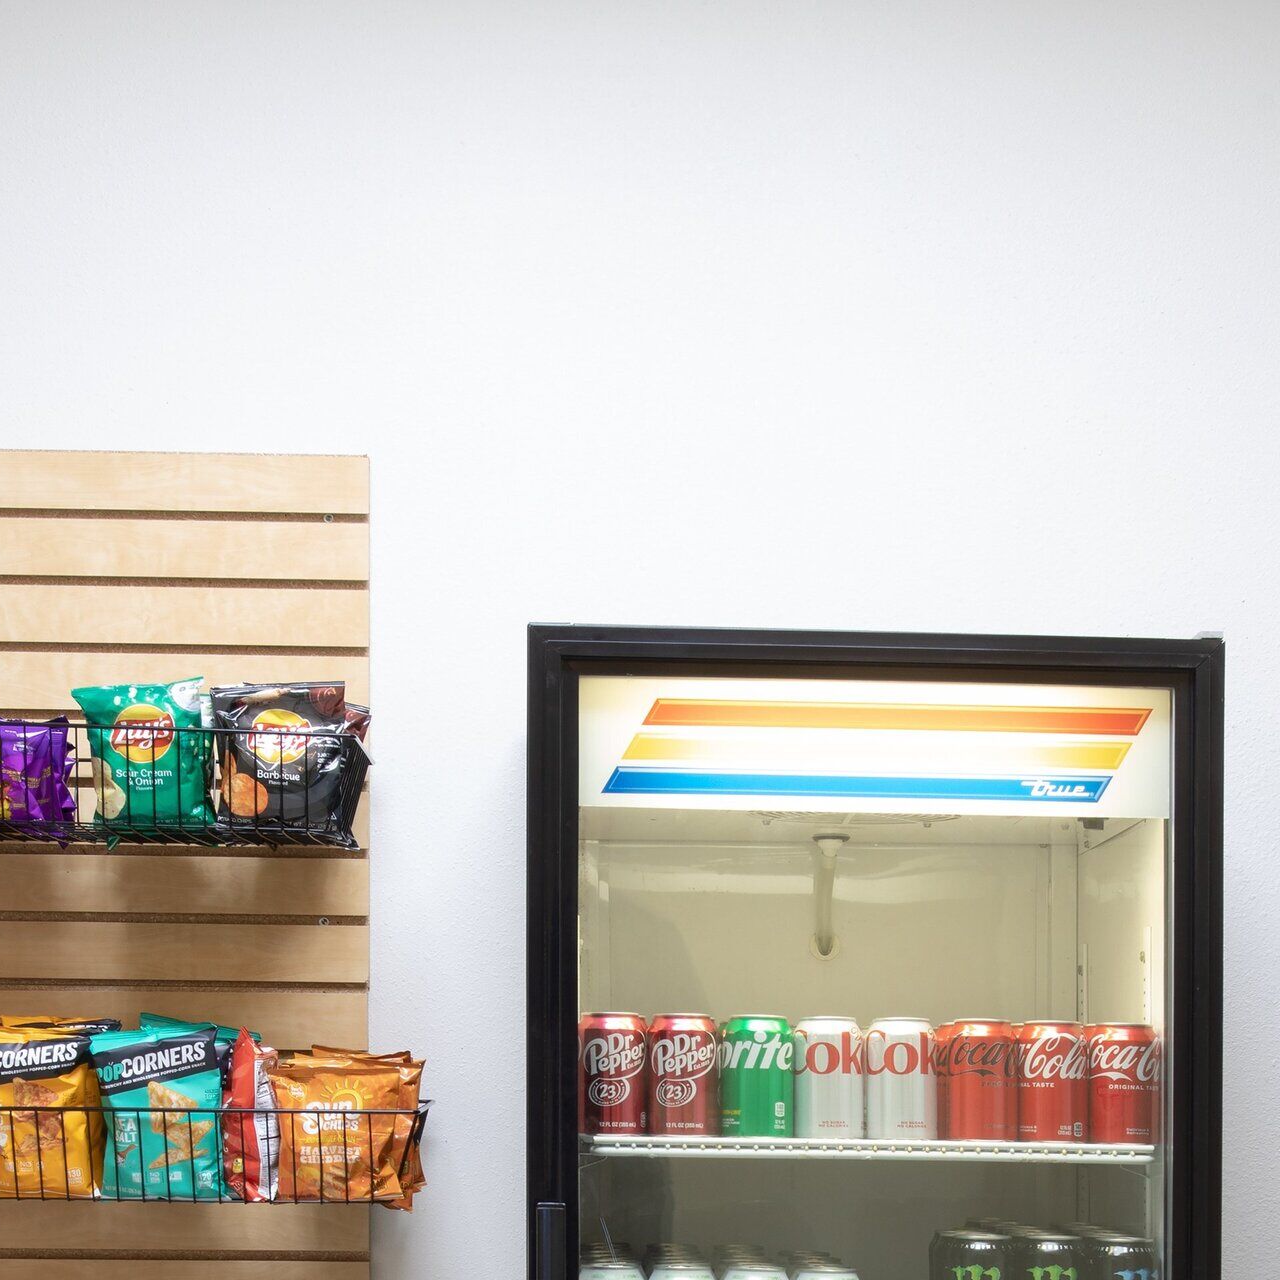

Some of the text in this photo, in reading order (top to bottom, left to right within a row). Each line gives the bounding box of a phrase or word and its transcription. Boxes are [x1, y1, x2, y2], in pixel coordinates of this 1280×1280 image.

[607, 1033, 635, 1051] Dr
[673, 1033, 701, 1051] Dr
[793, 1029, 863, 1075] Cok
[866, 1029, 937, 1076] Cok
[583, 1039, 645, 1076] Pepper
[651, 1038, 714, 1076] Pepper
[599, 1084, 618, 1099] 23
[665, 1085, 683, 1100] 23
